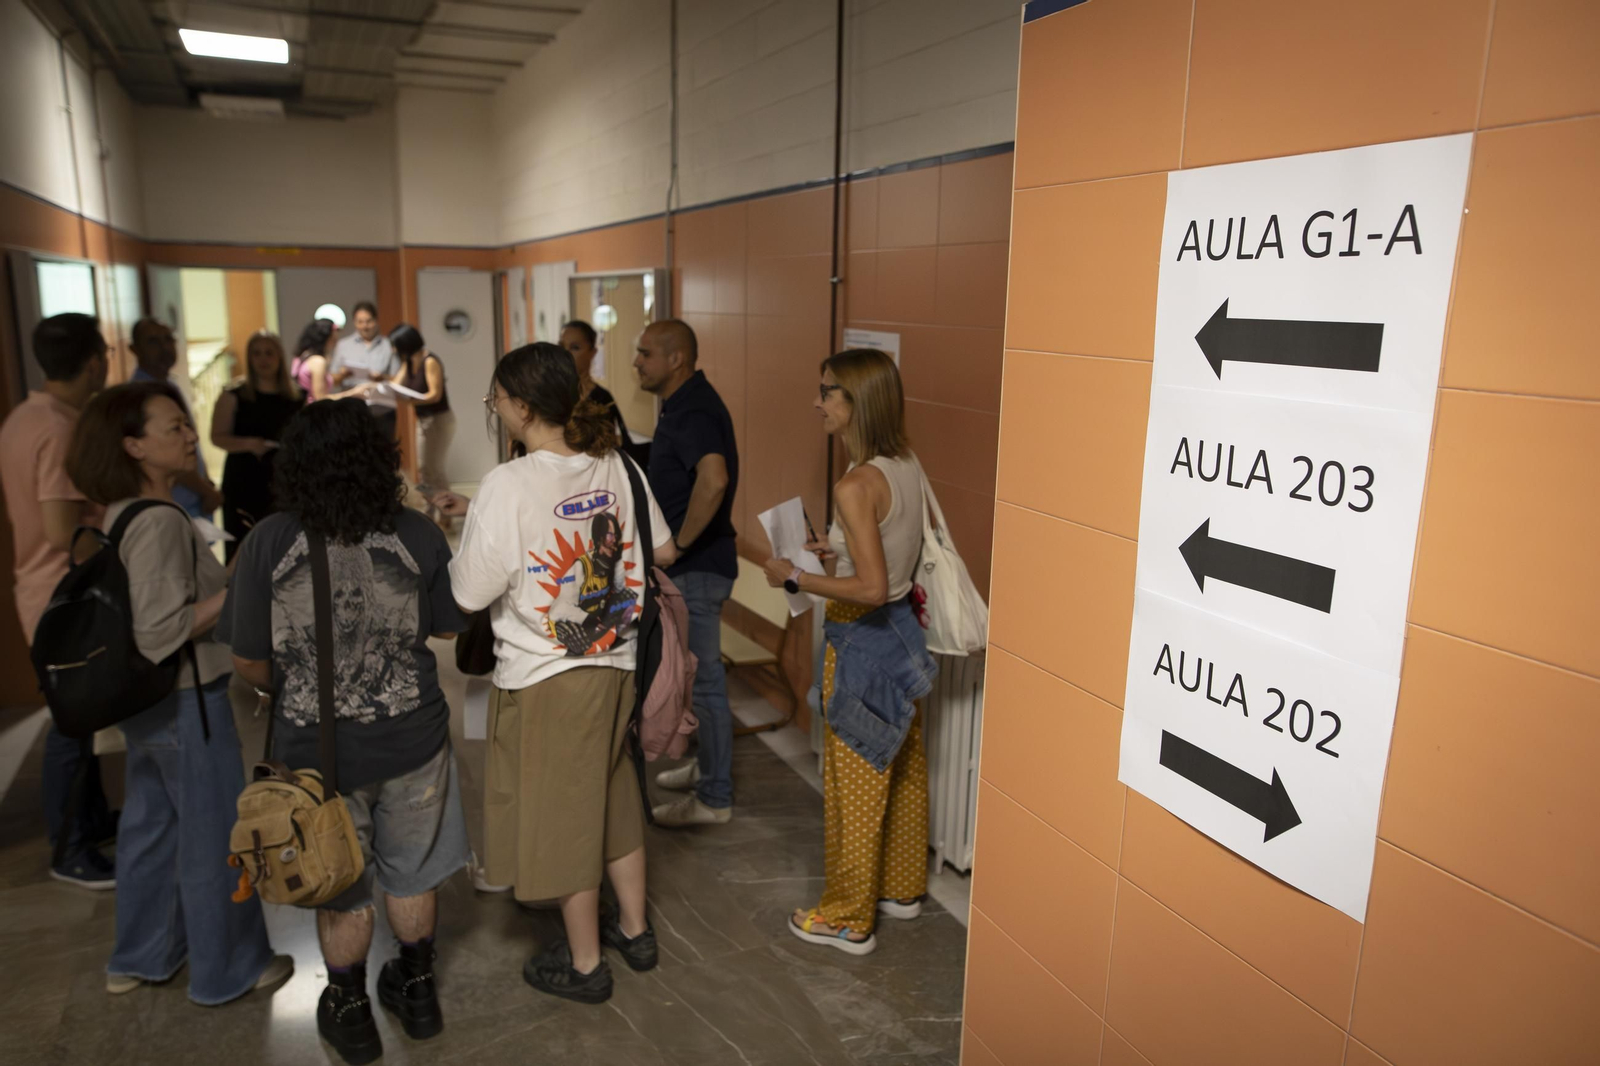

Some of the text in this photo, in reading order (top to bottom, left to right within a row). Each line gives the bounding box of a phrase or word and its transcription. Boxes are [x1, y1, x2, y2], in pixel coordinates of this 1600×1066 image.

[1176, 204, 1423, 262] AULA G1-A
[562, 494, 610, 516] BILLIE
[1170, 436, 1375, 513] AULA 203
[1152, 643, 1342, 759] AULA 202
